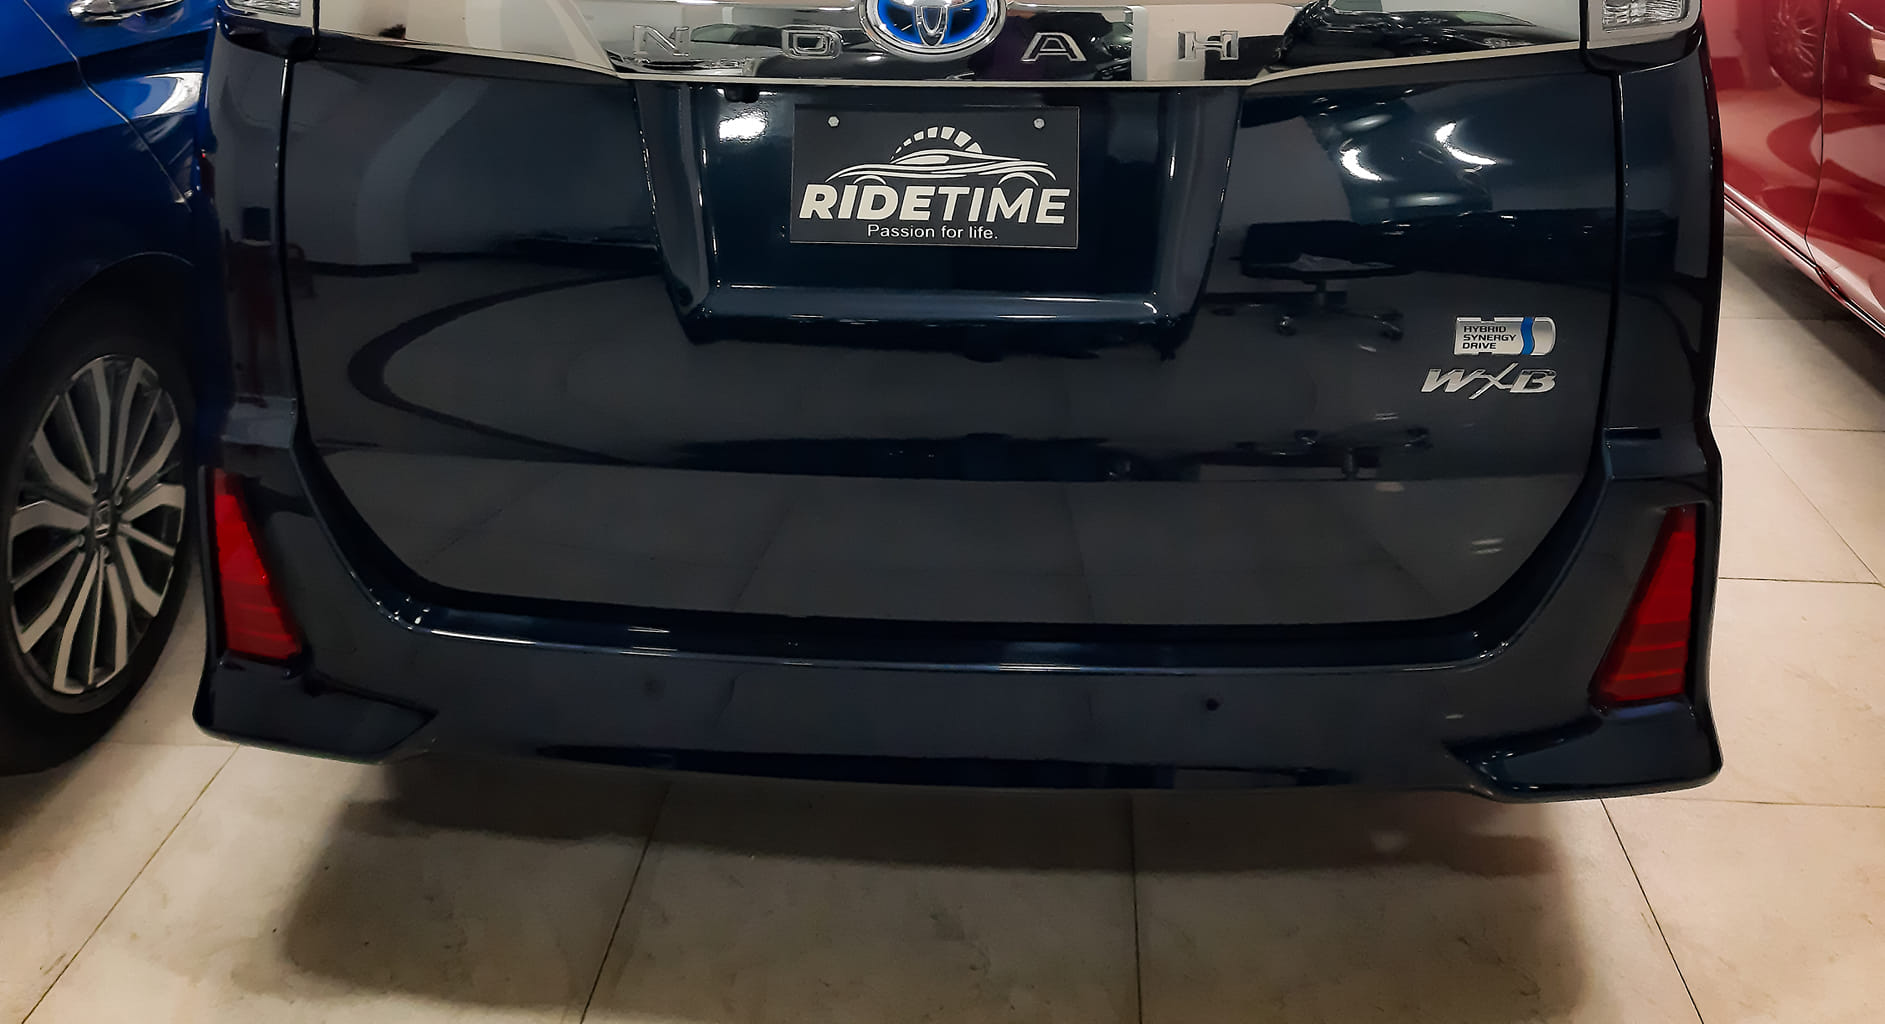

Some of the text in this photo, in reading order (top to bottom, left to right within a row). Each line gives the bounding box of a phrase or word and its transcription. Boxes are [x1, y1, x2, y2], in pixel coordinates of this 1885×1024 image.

[799, 184, 1071, 224] RIDETIME
[867, 224, 999, 240] Passion for life.
[1463, 325, 1507, 333] HYBRID
[1462, 334, 1517, 342] SYNERGY
[1462, 342, 1497, 350] DRIVE
